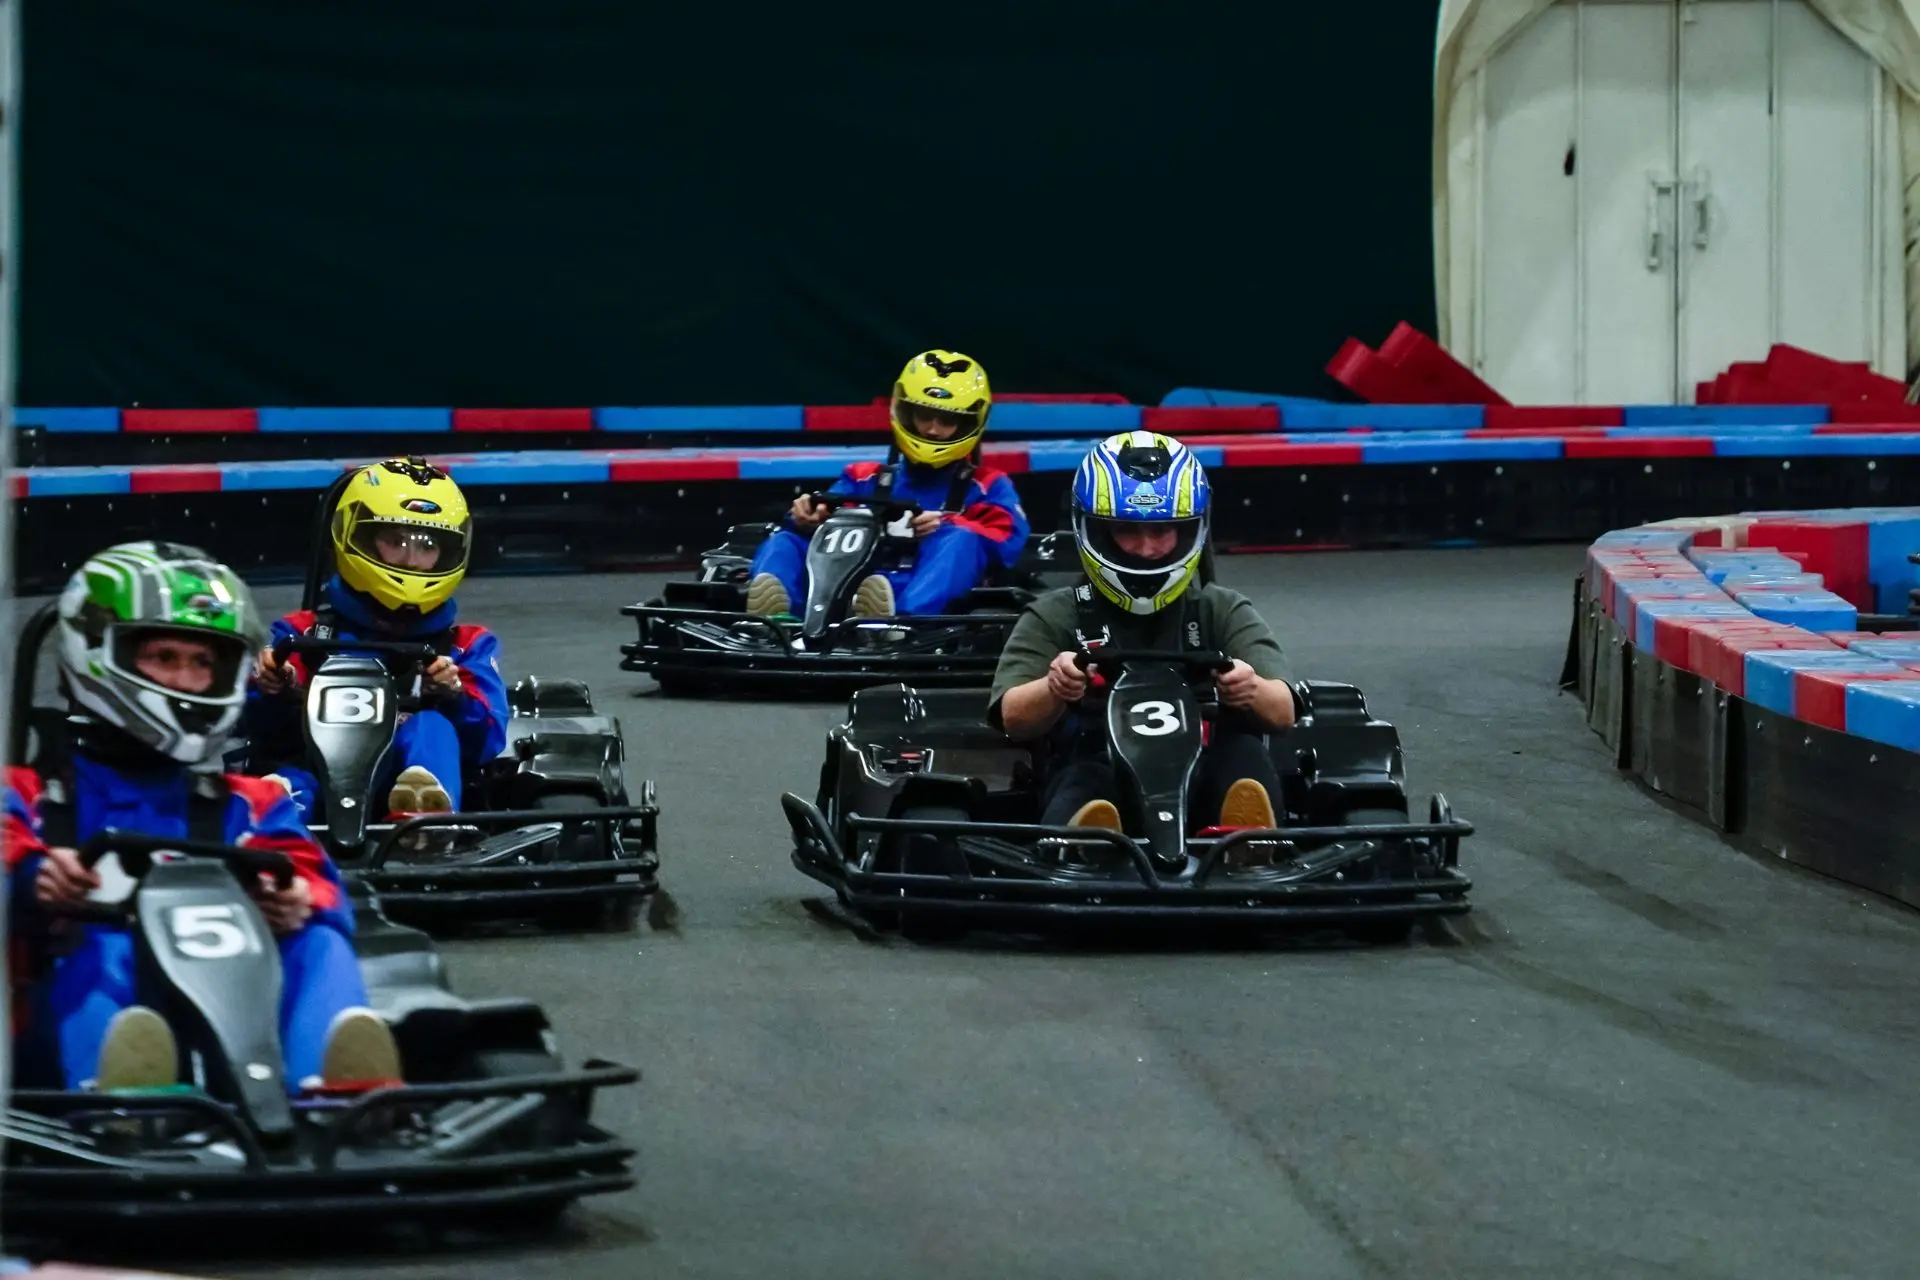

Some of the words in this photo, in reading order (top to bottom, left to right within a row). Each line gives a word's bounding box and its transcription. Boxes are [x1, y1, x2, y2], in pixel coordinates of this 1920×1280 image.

[824, 528, 865, 553] 10
[1187, 621, 1200, 648] OMP
[1130, 701, 1180, 736] 3
[172, 904, 245, 958] 5
